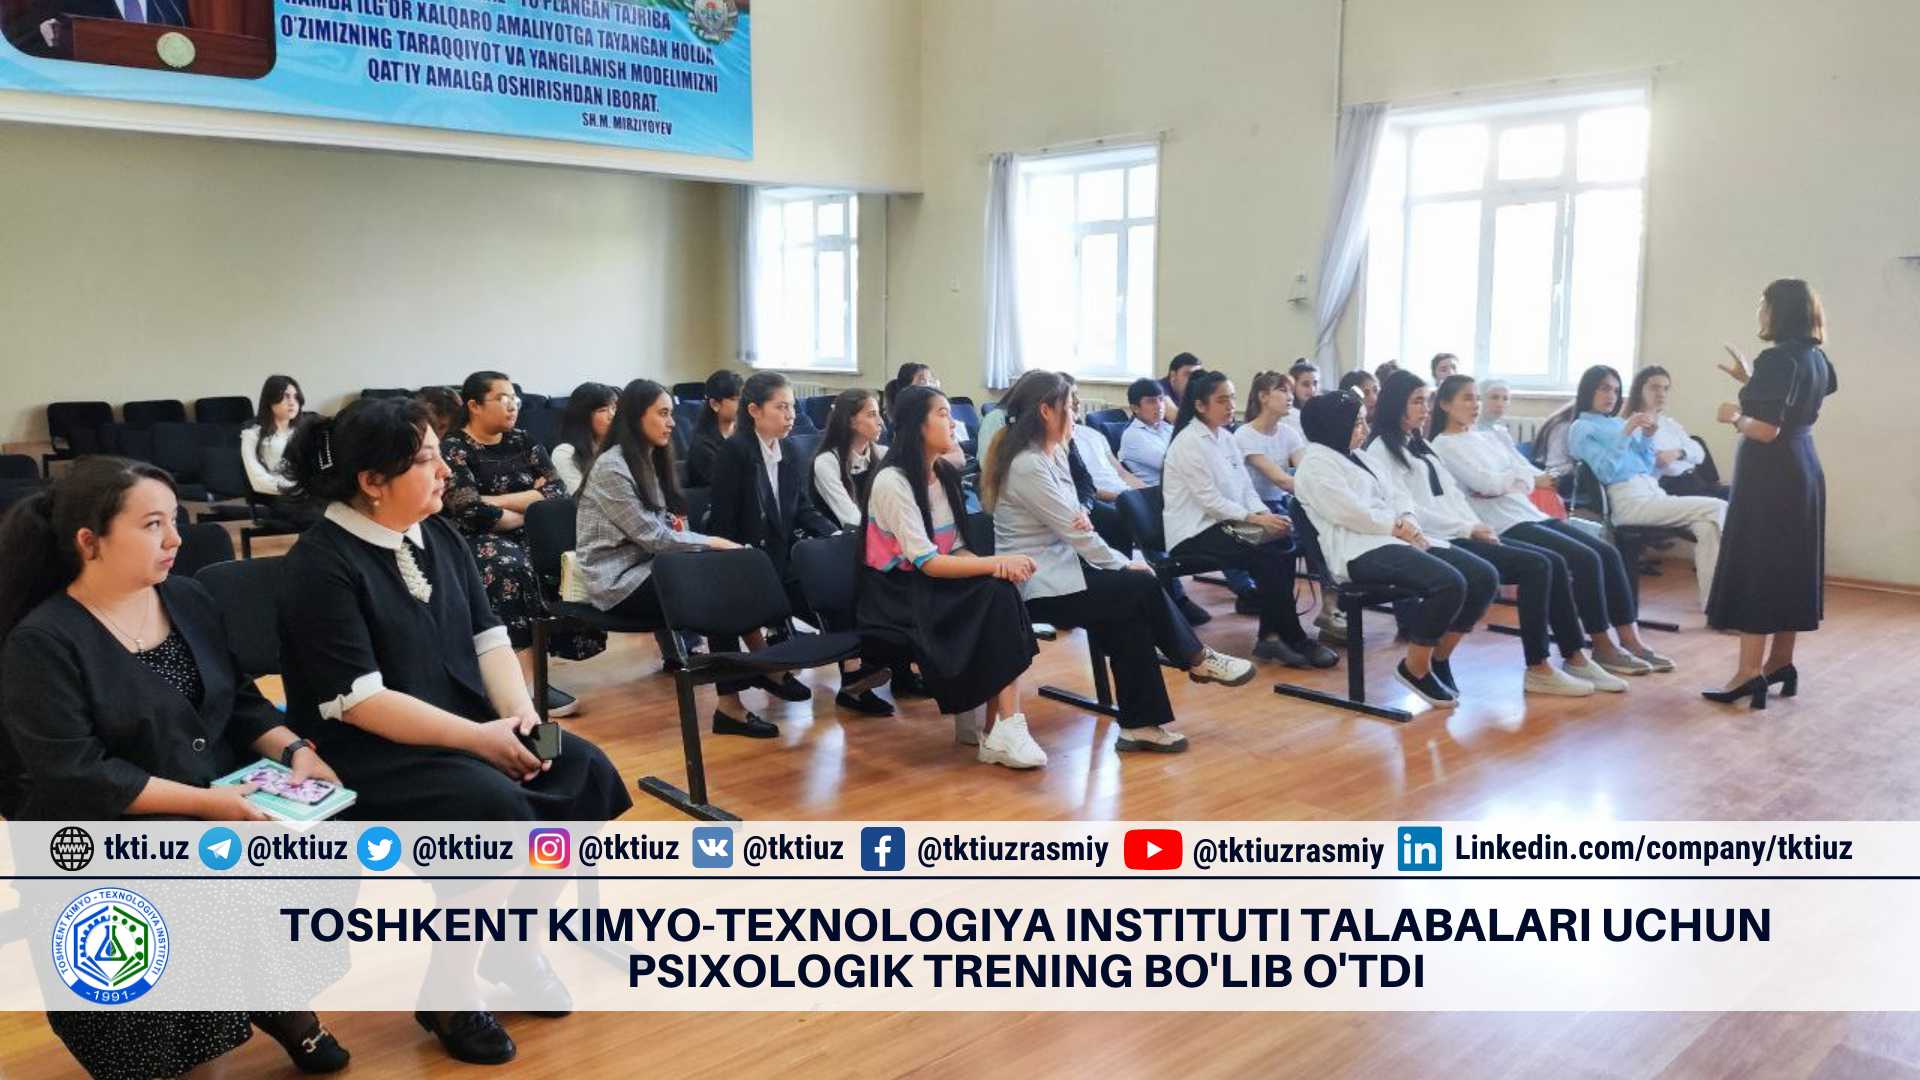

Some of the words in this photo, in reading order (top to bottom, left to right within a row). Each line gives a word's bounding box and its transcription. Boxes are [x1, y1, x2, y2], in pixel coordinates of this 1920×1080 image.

[416, 2, 492, 32] XALQARO
[496, 14, 594, 47] AMALIYOTGA
[597, 30, 667, 58] TAYANGAN
[671, 41, 714, 66] HOLDA
[615, 3, 671, 31] TAJRIBA
[280, 14, 393, 49] O'ZIMIZNING
[397, 30, 500, 64] TARAQQIYOT
[505, 45, 526, 67] VA
[529, 48, 627, 80] YANGILANISH
[631, 63, 718, 93] MODELIMIZNI
[368, 57, 421, 84] QAT'IY
[426, 65, 494, 93] AMALGA
[497, 74, 603, 107] OSHIRISHDAN
[607, 89, 660, 113] IBORAT.
[613, 115, 673, 136] MIRZIYOYEV
